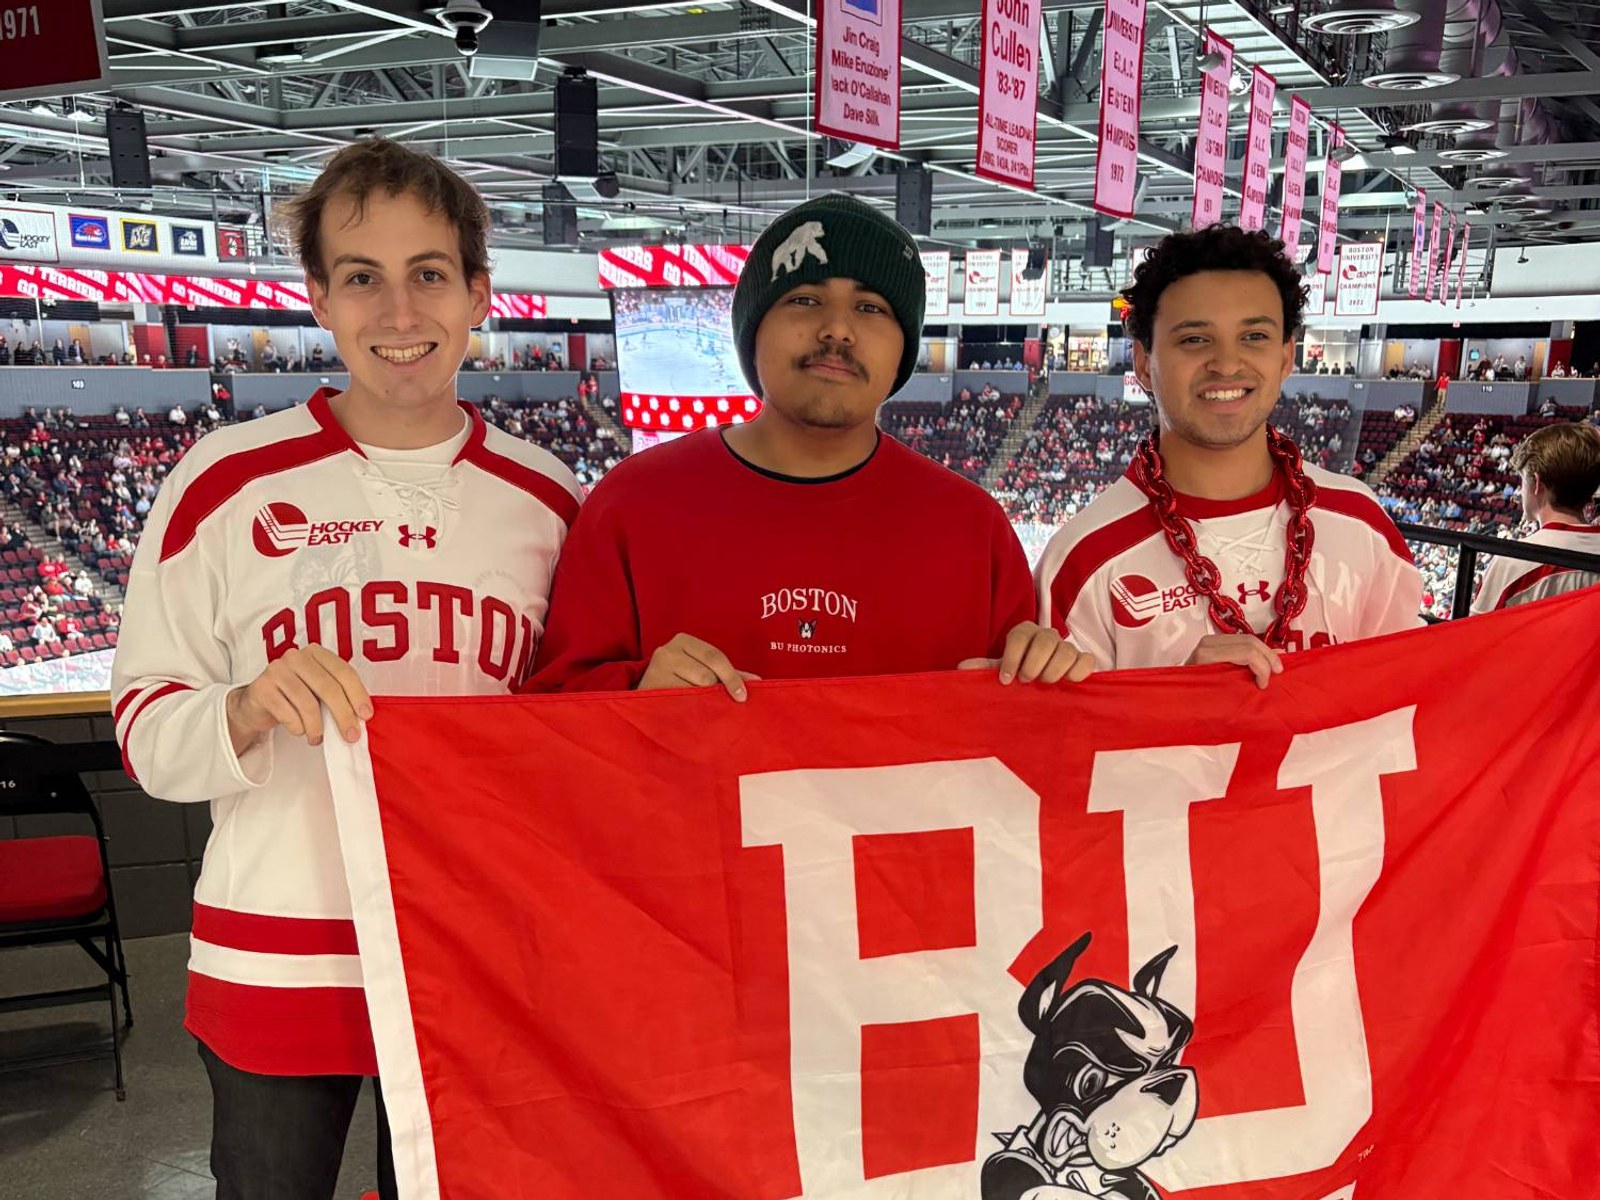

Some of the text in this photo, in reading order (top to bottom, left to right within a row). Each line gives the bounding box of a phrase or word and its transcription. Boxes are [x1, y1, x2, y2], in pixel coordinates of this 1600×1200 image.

[0, 6, 40, 40] 971
[843, 26, 879, 57] Jim Craig
[991, 21, 1031, 72] Cullen
[832, 49, 853, 69] Mike
[851, 81, 891, 106] O'Callahan
[843, 103, 879, 126] Dave Silk
[20, 234, 50, 243] HOCKEY
[17, 278, 38, 298] GO
[309, 520, 384, 535] HOCKEY
[307, 532, 353, 547] EAST
[1161, 585, 1200, 602] HOC
[1162, 594, 1200, 613] EAST
[761, 588, 858, 623] BOSTON
[770, 641, 848, 654] BU PHOTONICS
[739, 704, 1417, 1200] BU
